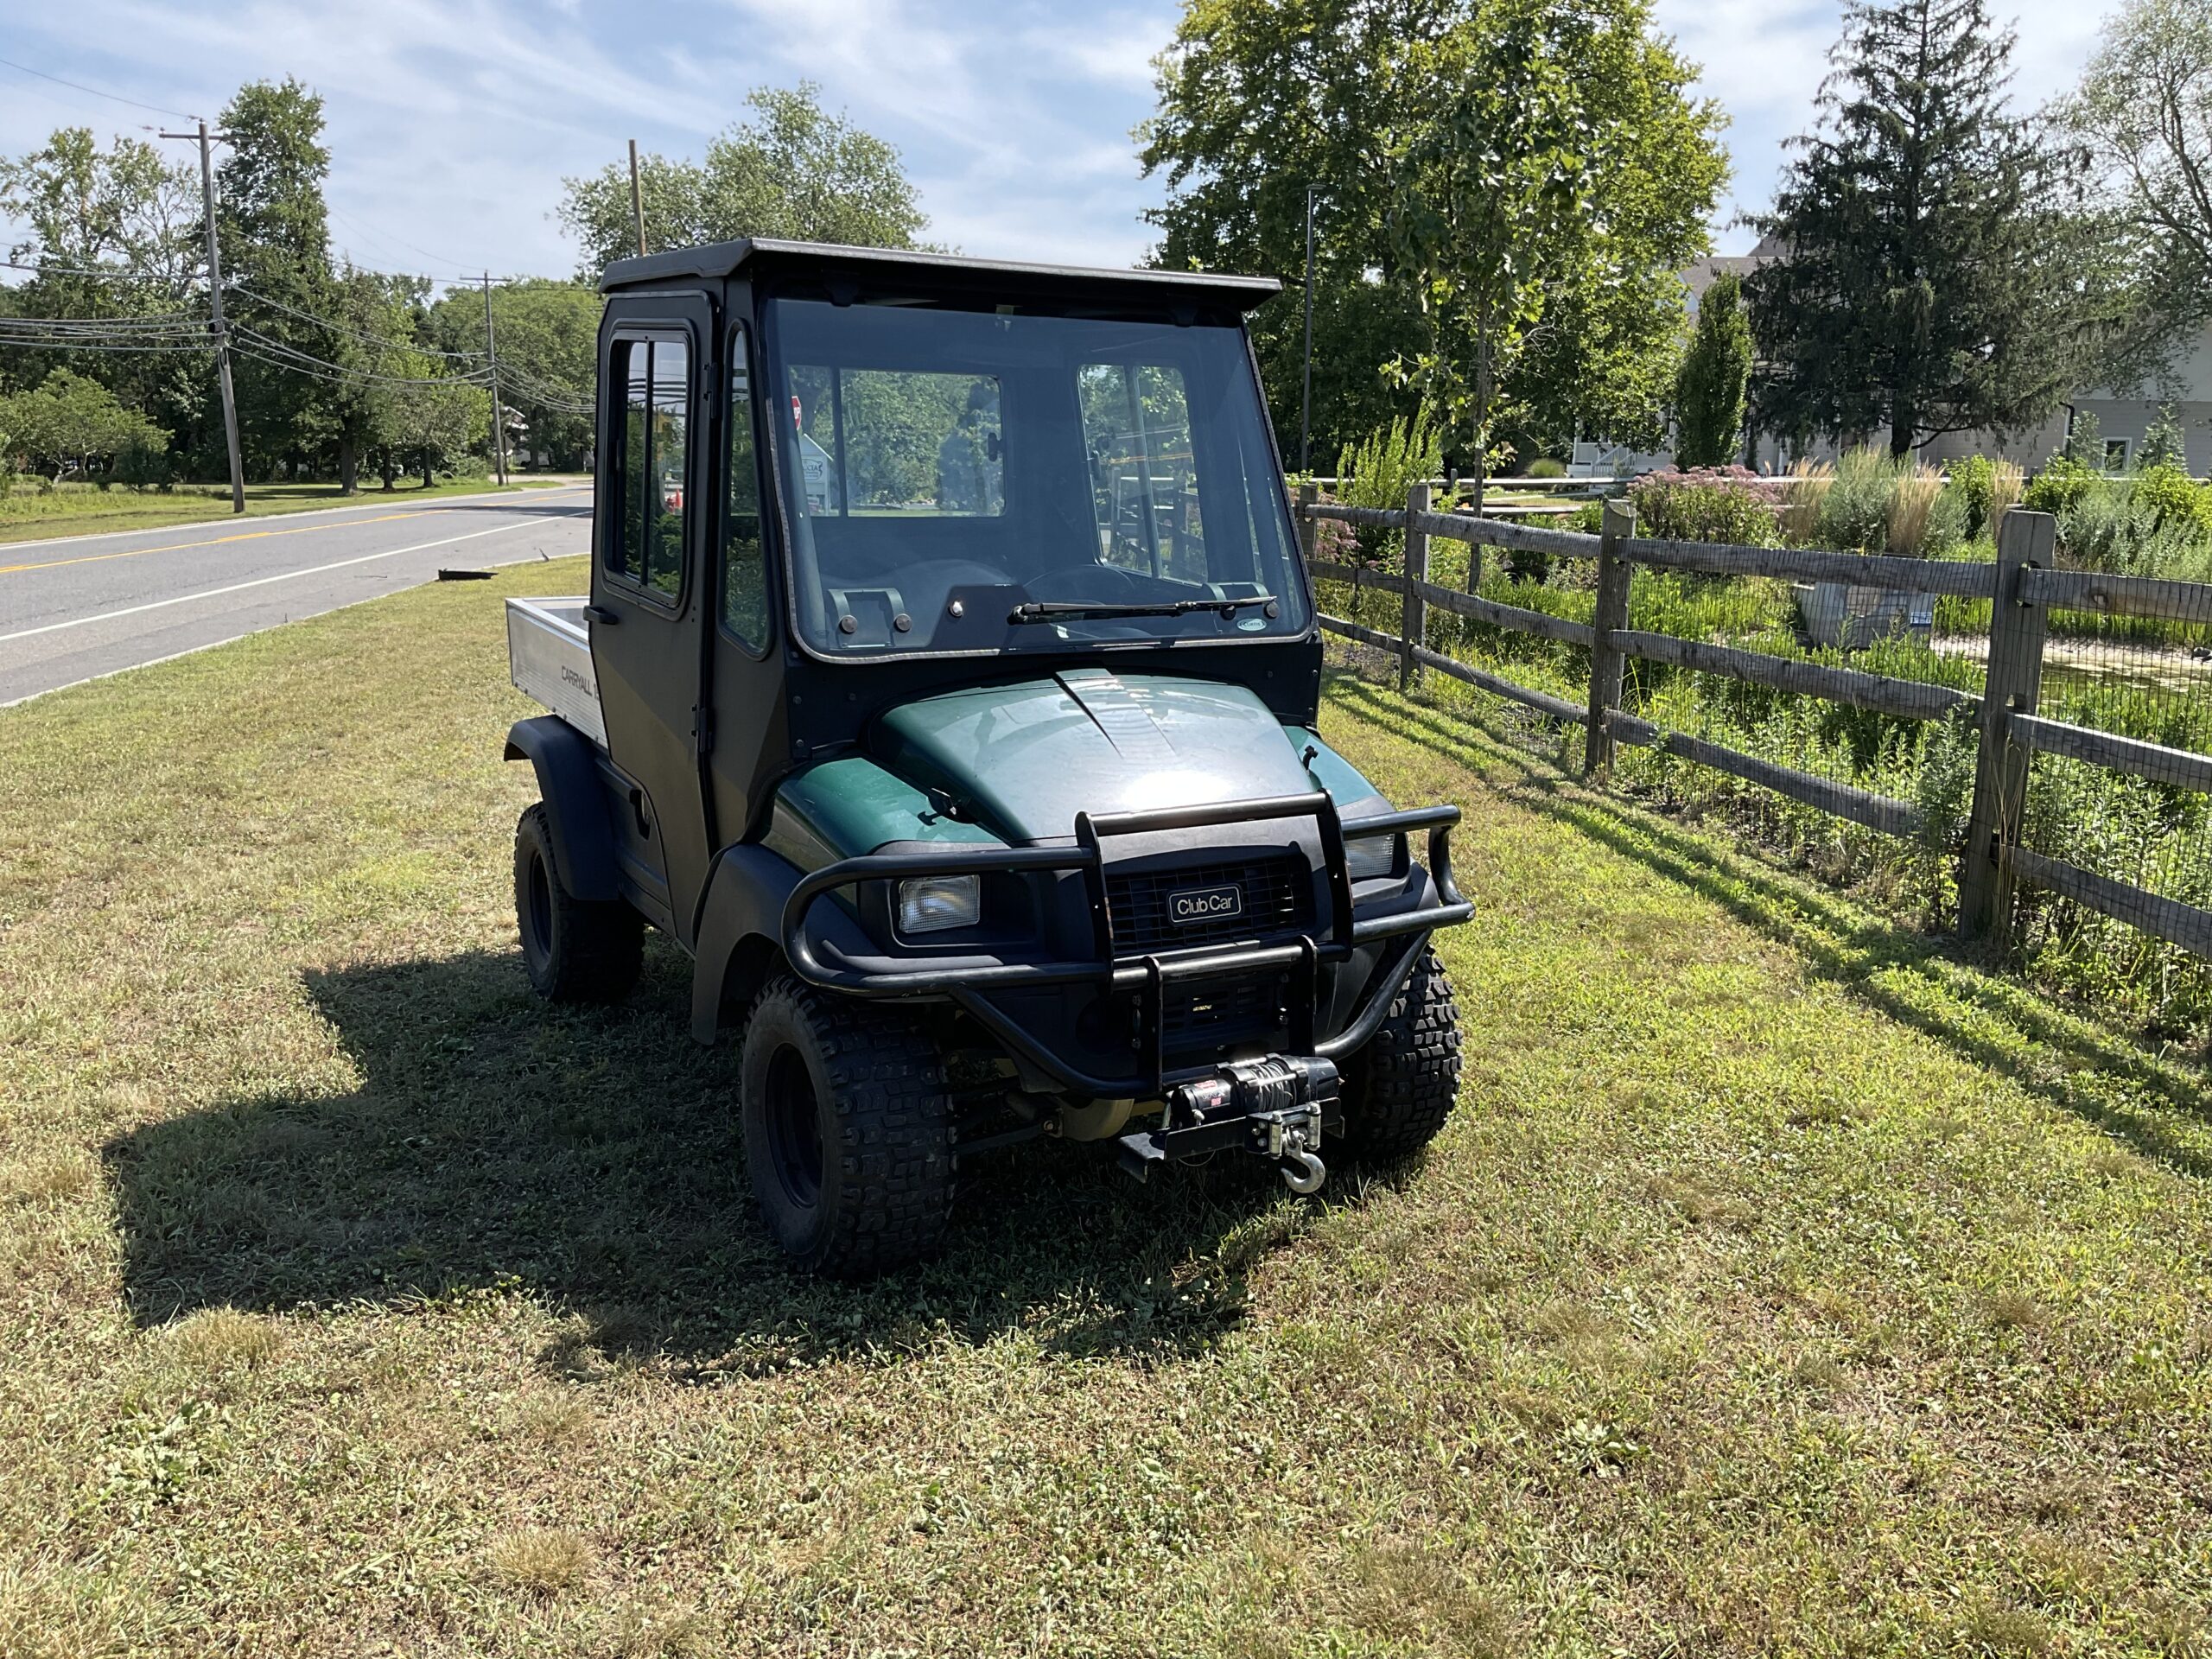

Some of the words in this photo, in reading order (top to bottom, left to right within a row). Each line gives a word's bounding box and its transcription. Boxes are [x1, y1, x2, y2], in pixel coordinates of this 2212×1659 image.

[562, 664, 593, 697] CARRYALL
[1177, 899, 1208, 915] Club
[1209, 895, 1232, 911] Car
